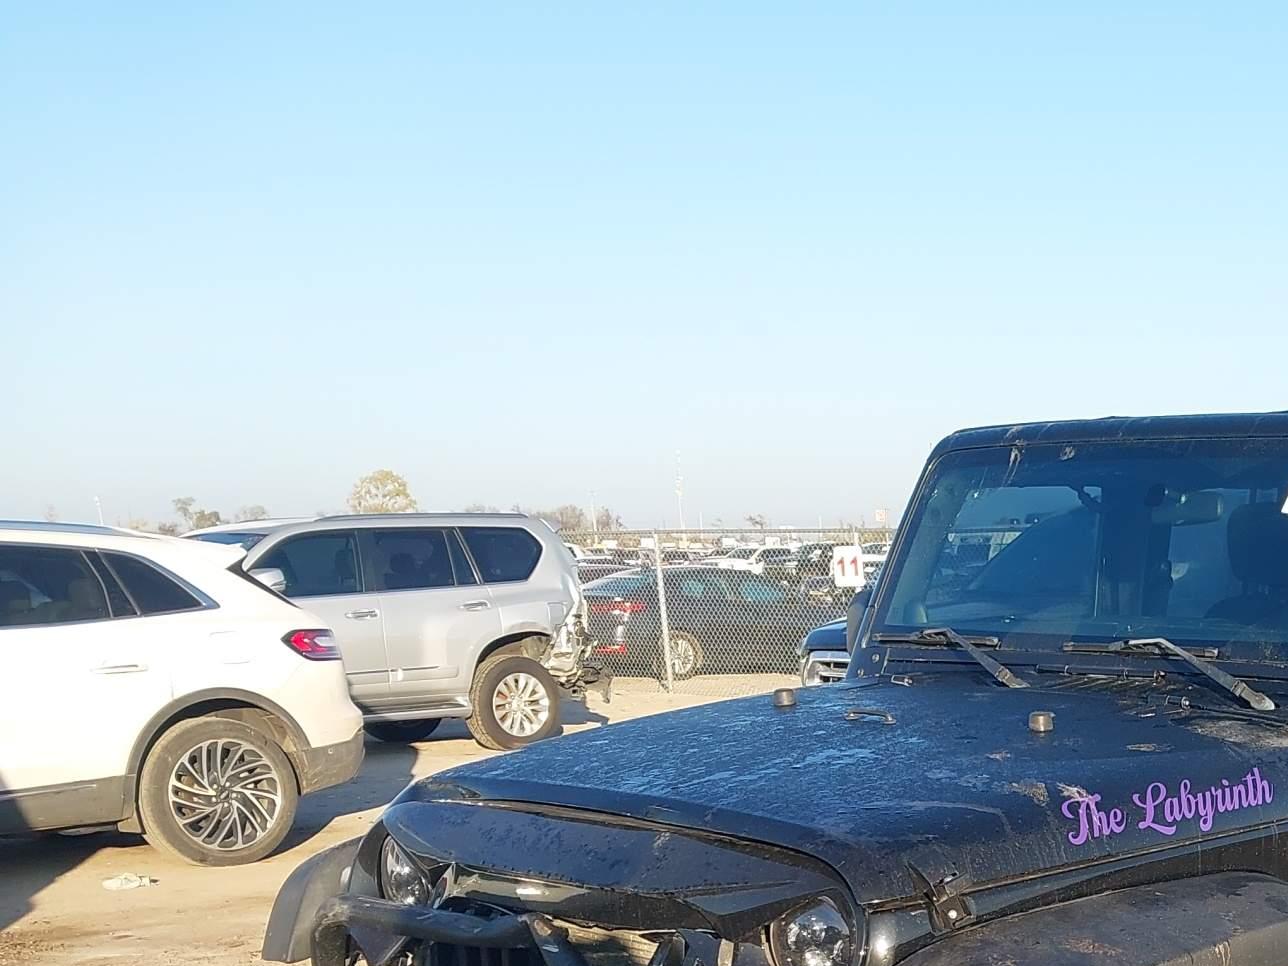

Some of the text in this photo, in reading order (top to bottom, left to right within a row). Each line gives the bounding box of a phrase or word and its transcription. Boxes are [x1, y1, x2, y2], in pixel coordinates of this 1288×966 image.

[837, 556, 859, 577] 11
[1061, 767, 1274, 846] The Labyrinth
